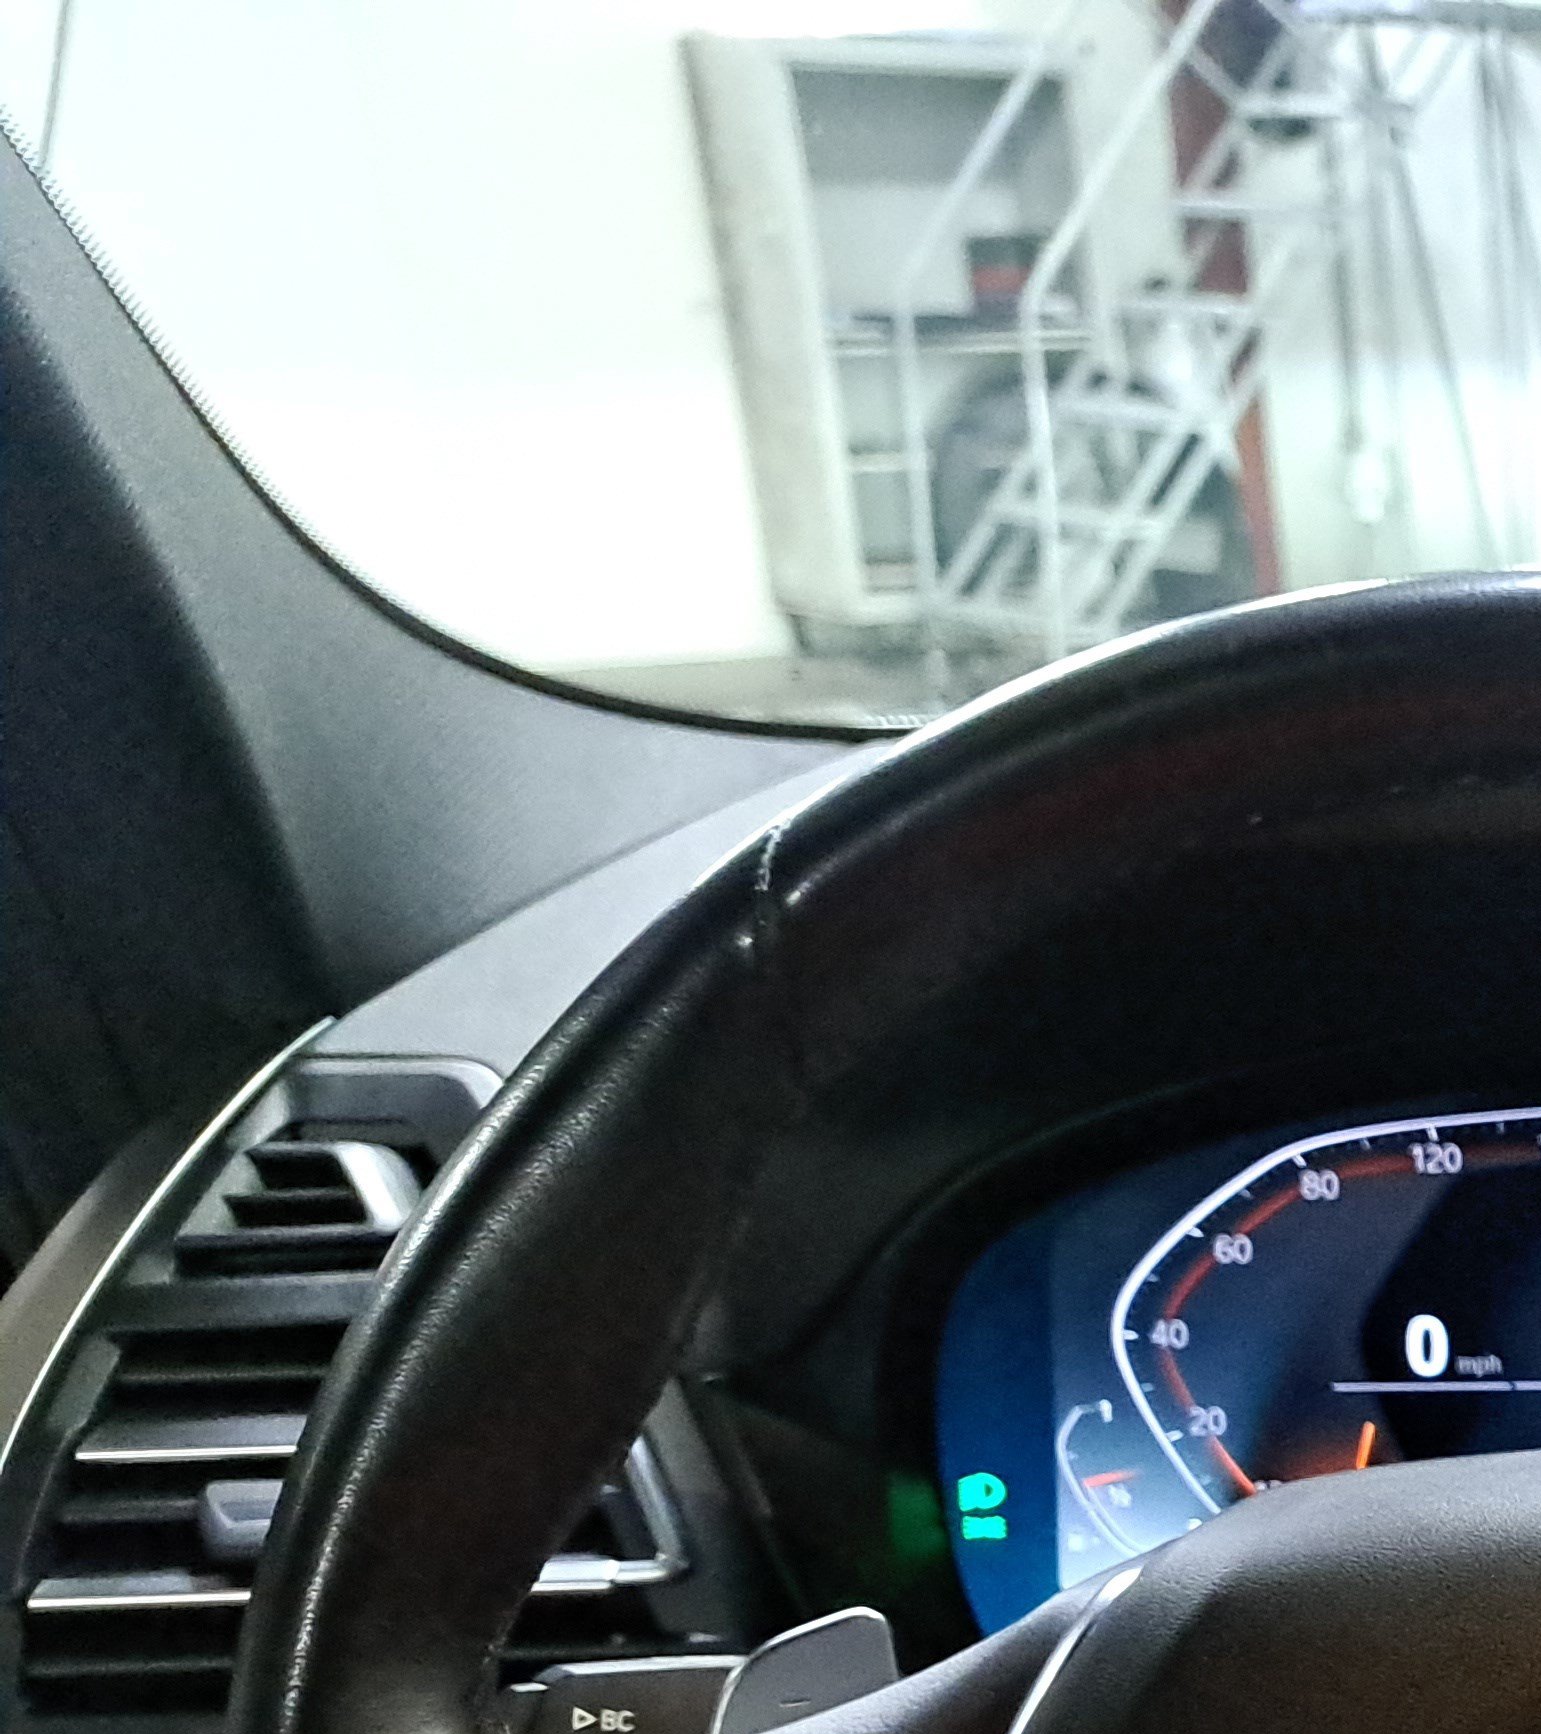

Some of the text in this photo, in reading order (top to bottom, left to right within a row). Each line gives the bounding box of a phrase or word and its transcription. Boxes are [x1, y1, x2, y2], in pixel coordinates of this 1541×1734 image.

[1409, 1142, 1463, 1174] 120
[1300, 1171, 1340, 1201] 80
[1213, 1236, 1254, 1265] 60
[1148, 1319, 1189, 1349] 40
[1405, 1314, 1502, 1378] 0 mph
[1189, 1405, 1227, 1436] 20
